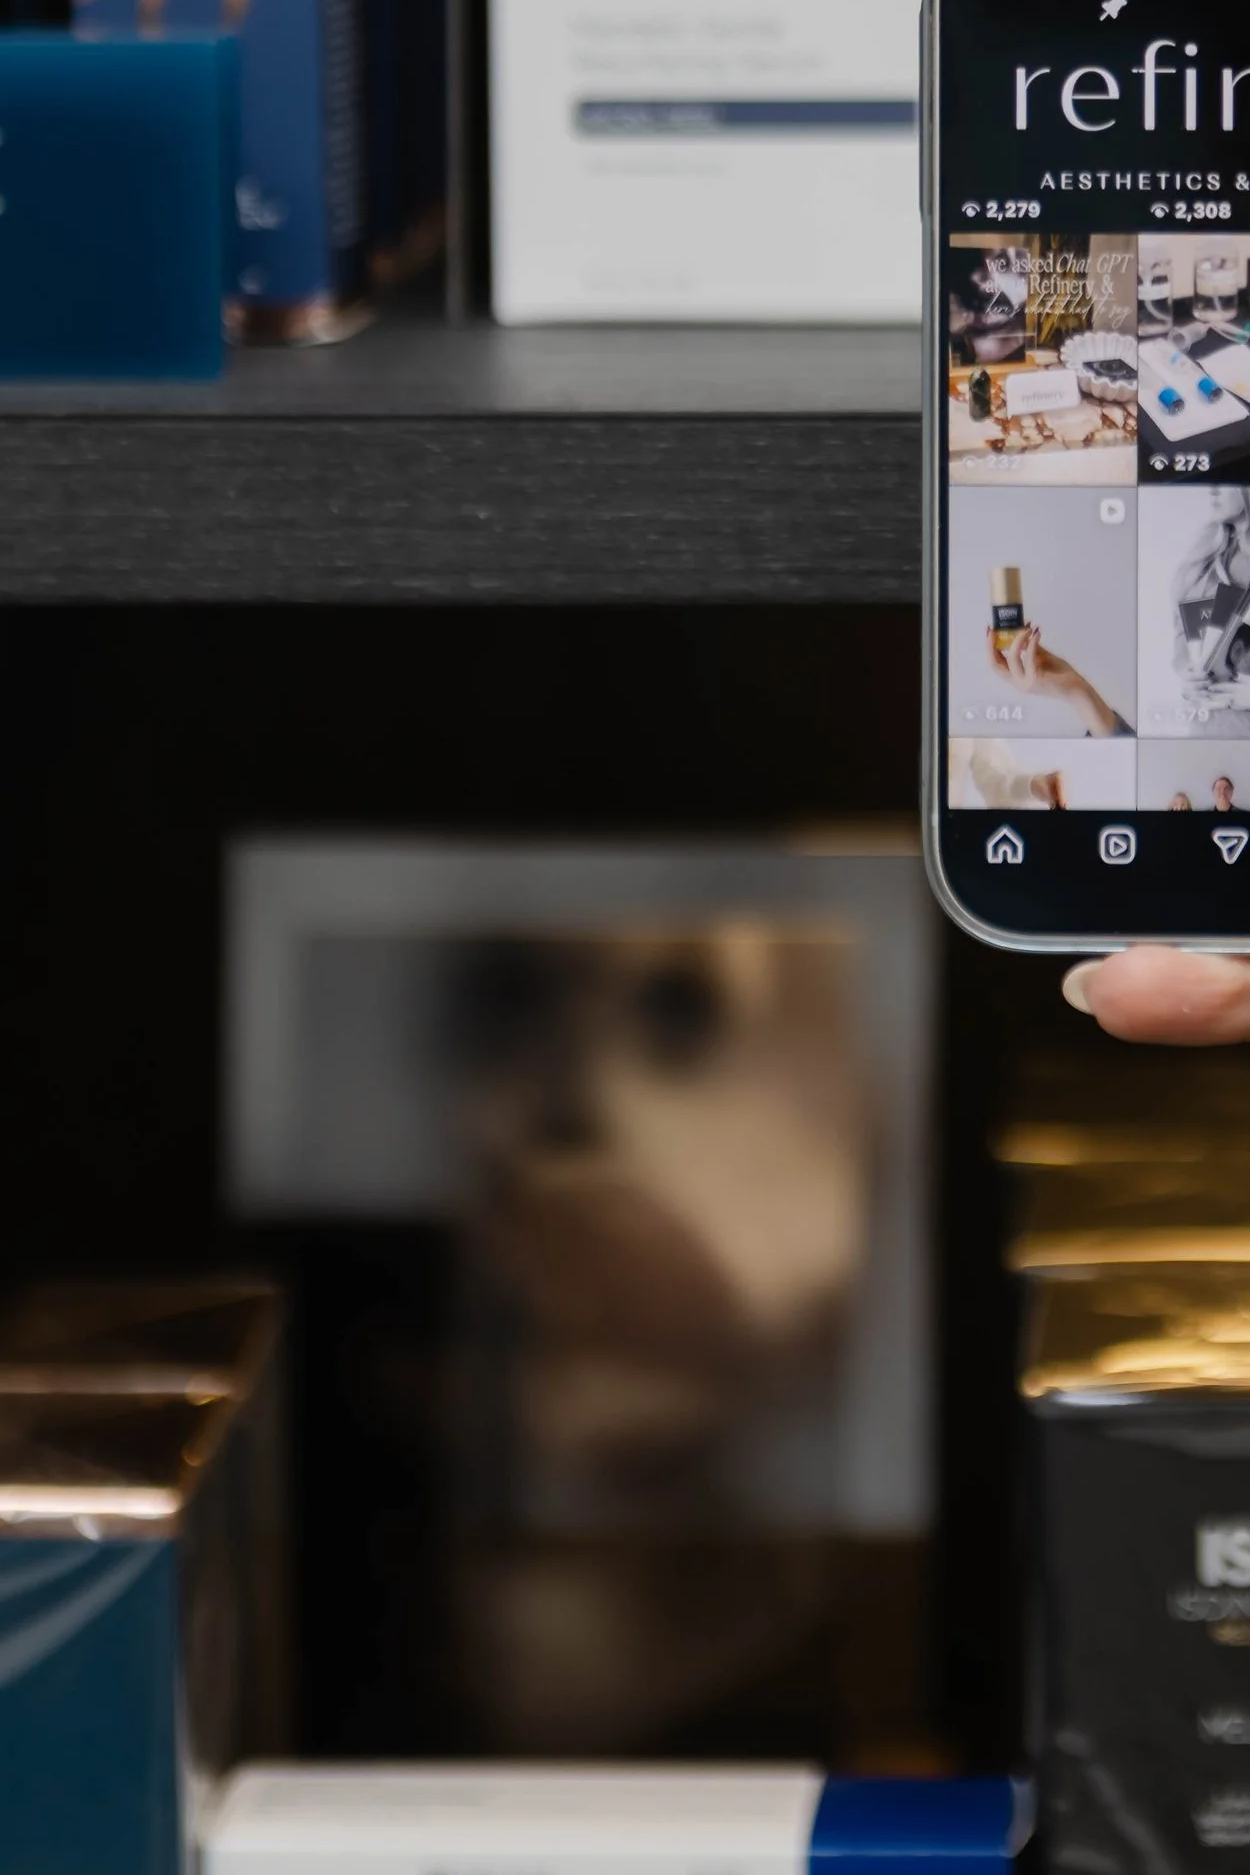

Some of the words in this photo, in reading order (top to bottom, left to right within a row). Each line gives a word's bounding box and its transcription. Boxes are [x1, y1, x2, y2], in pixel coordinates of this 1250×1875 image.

[1040, 172, 1221, 190] AESTHETICS
[1235, 173, 1250, 191] &
[985, 200, 1041, 222] 2,279
[1174, 201, 1232, 222] 2,308
[985, 258, 1007, 273] we
[1012, 252, 1054, 273] asked
[1096, 254, 1134, 274] GPT
[1029, 274, 1095, 299] Refinery
[1101, 274, 1114, 294] &
[985, 454, 1022, 470] 232
[1173, 455, 1211, 472] 273
[985, 705, 1024, 722] 644
